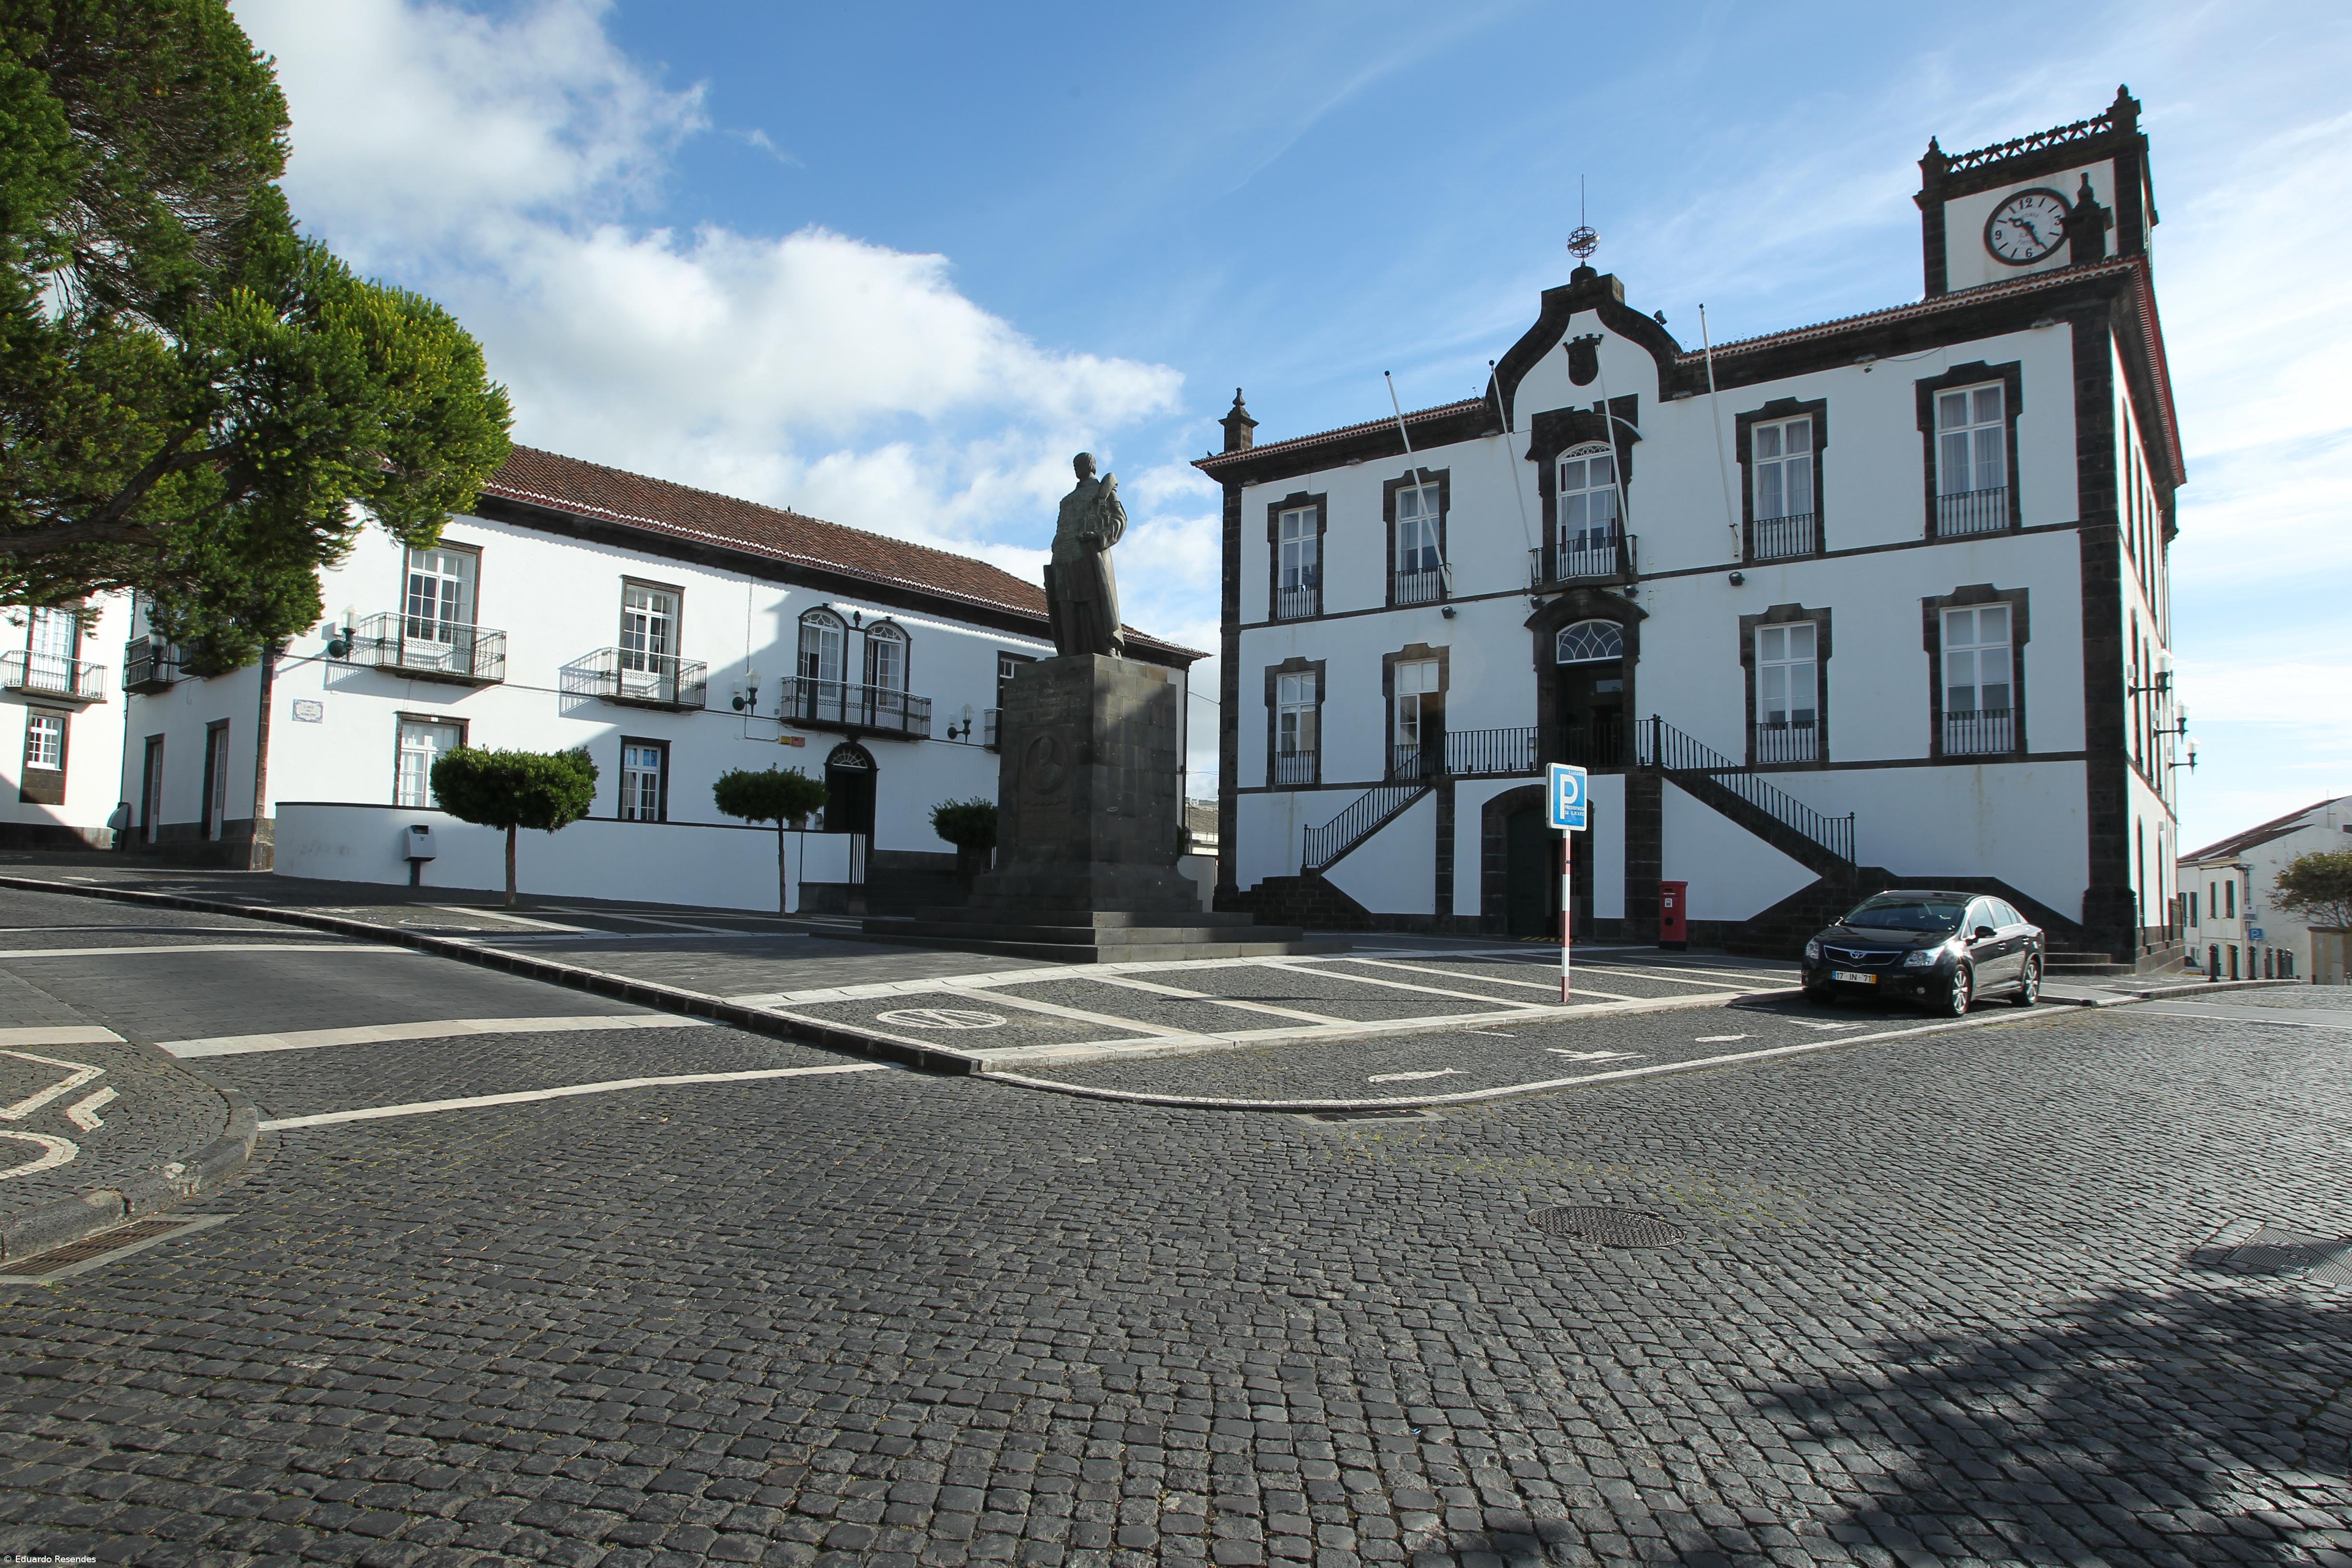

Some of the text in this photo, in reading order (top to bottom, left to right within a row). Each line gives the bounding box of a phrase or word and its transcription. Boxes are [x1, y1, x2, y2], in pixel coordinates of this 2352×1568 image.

[2019, 197, 2033, 209] 12
[2054, 214, 2061, 226] 3
[1995, 230, 2002, 240] 9
[2025, 247, 2033, 258] 6
[1560, 773, 1579, 820] P
[2252, 929, 2259, 939] P
